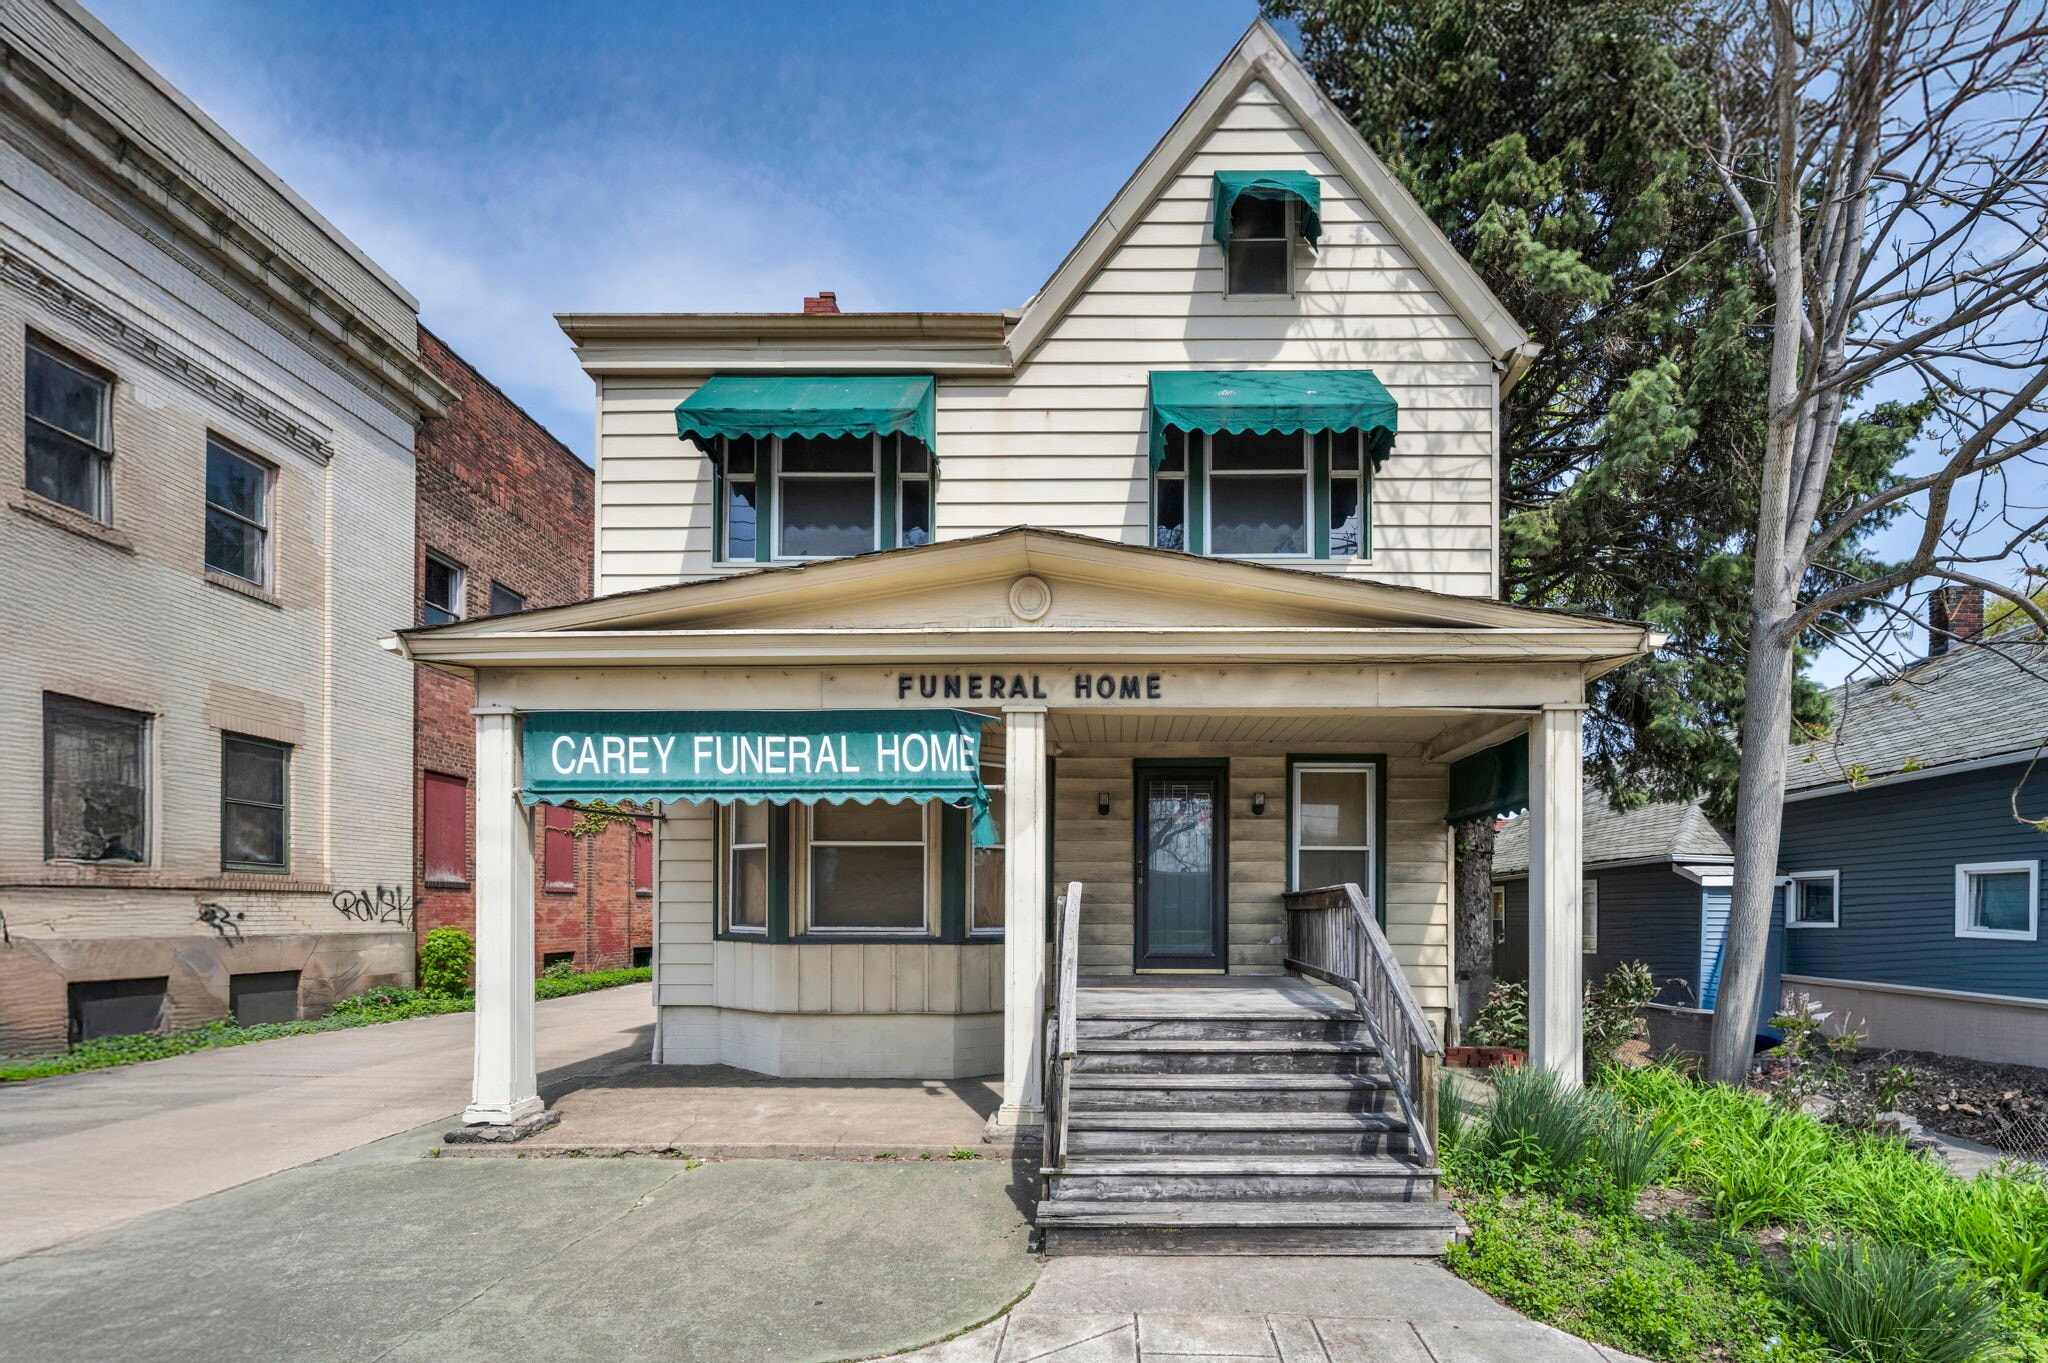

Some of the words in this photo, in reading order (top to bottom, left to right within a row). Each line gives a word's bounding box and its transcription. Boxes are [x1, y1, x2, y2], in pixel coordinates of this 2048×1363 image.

[898, 675, 1047, 699] FUNERAL
[1074, 674, 1161, 699] HOME
[551, 735, 676, 774] CAREY
[694, 734, 860, 774] FUNERAL
[877, 733, 975, 773] HOME
